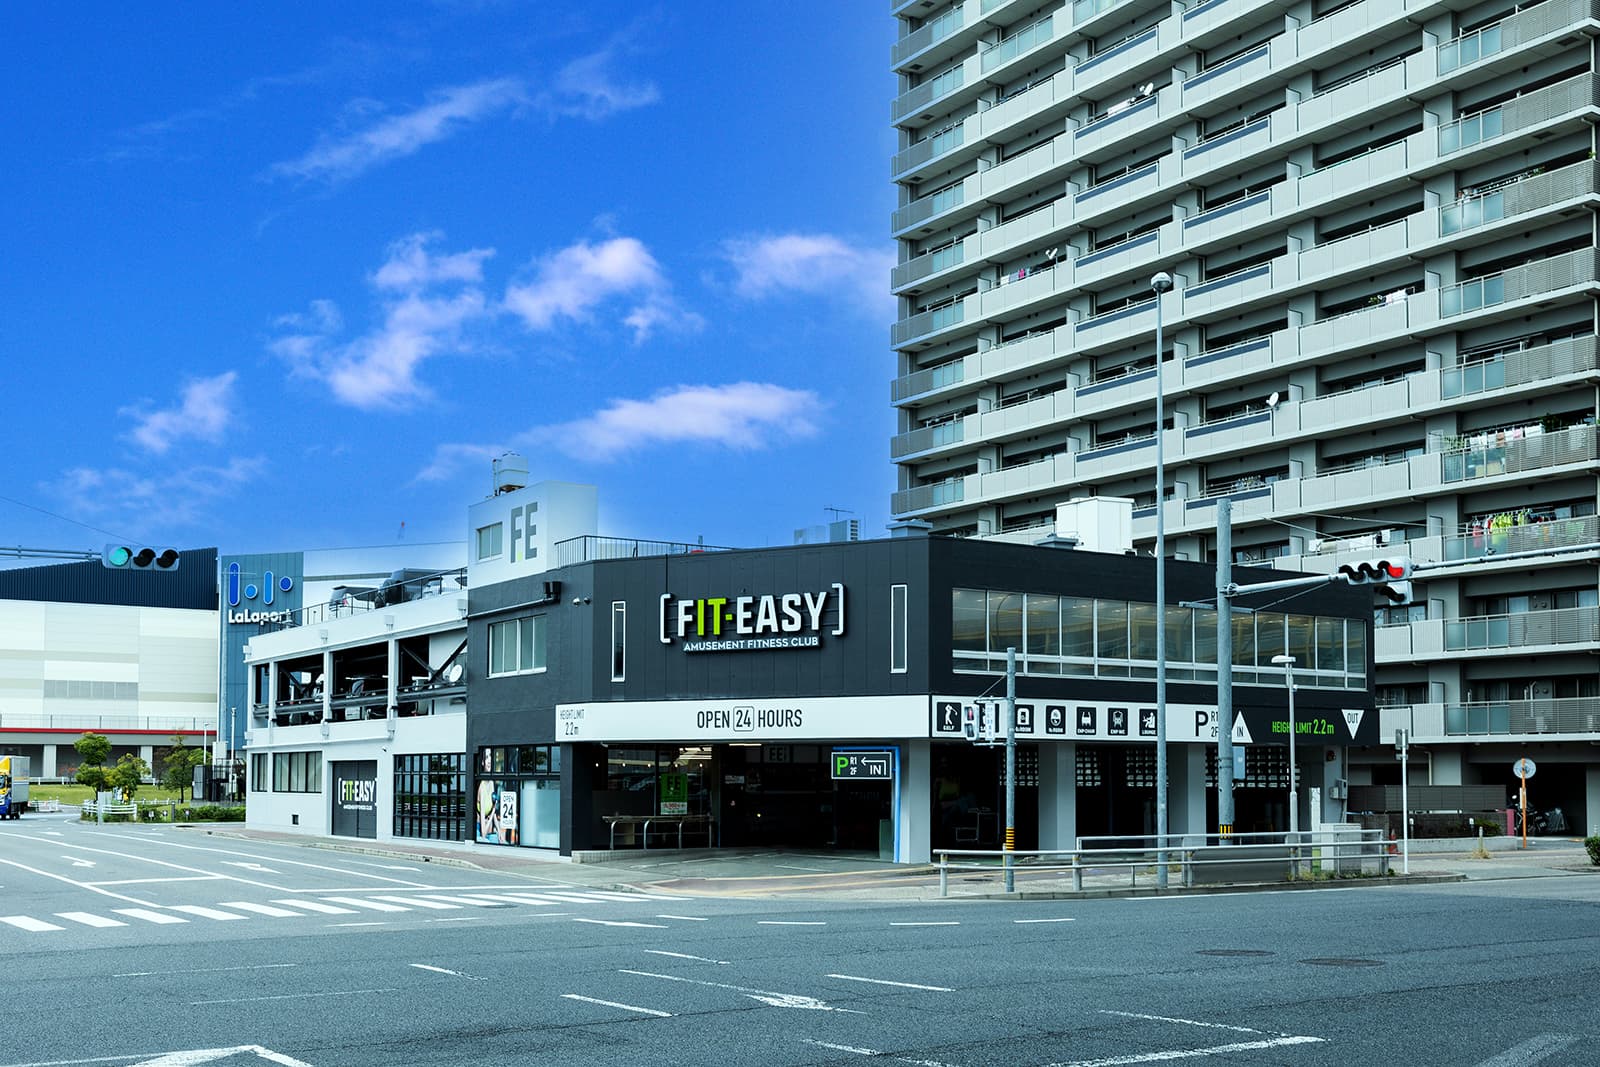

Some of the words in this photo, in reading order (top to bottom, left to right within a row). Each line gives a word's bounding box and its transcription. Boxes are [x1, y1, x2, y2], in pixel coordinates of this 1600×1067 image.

[684, 640, 745, 651] AMUSEMENT
[748, 638, 788, 648] FITNESS
[791, 637, 818, 647] CLUB
[697, 711, 730, 728] OPEN
[736, 710, 751, 727] 24
[758, 709, 802, 727] HOURS
[1195, 711, 1208, 736] P
[1347, 713, 1358, 723] OUT
[1237, 727, 1243, 736] IN
[1272, 721, 1290, 733] HEIGH
[1295, 722, 1312, 733] LIMIT
[836, 757, 848, 775] P
[850, 757, 857, 765] R1
[850, 767, 857, 775] 2F
[870, 765, 881, 775] IN
[503, 804, 514, 819] 24
